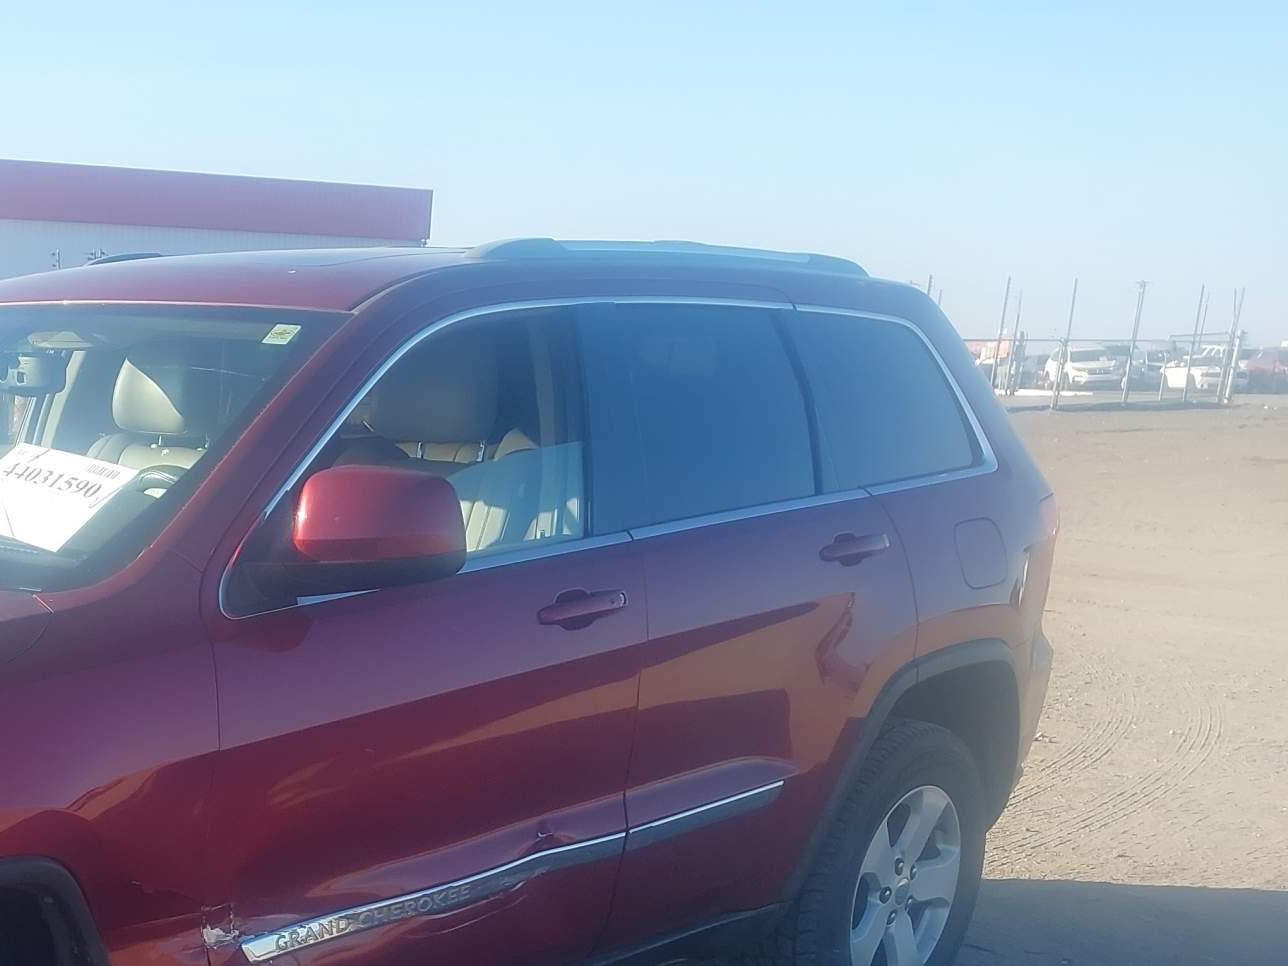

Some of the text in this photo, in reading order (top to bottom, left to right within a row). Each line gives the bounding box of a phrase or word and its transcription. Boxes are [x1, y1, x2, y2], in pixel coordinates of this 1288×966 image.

[2, 461, 103, 498] 44031590
[273, 884, 473, 954] GRAND CHEROKEE
